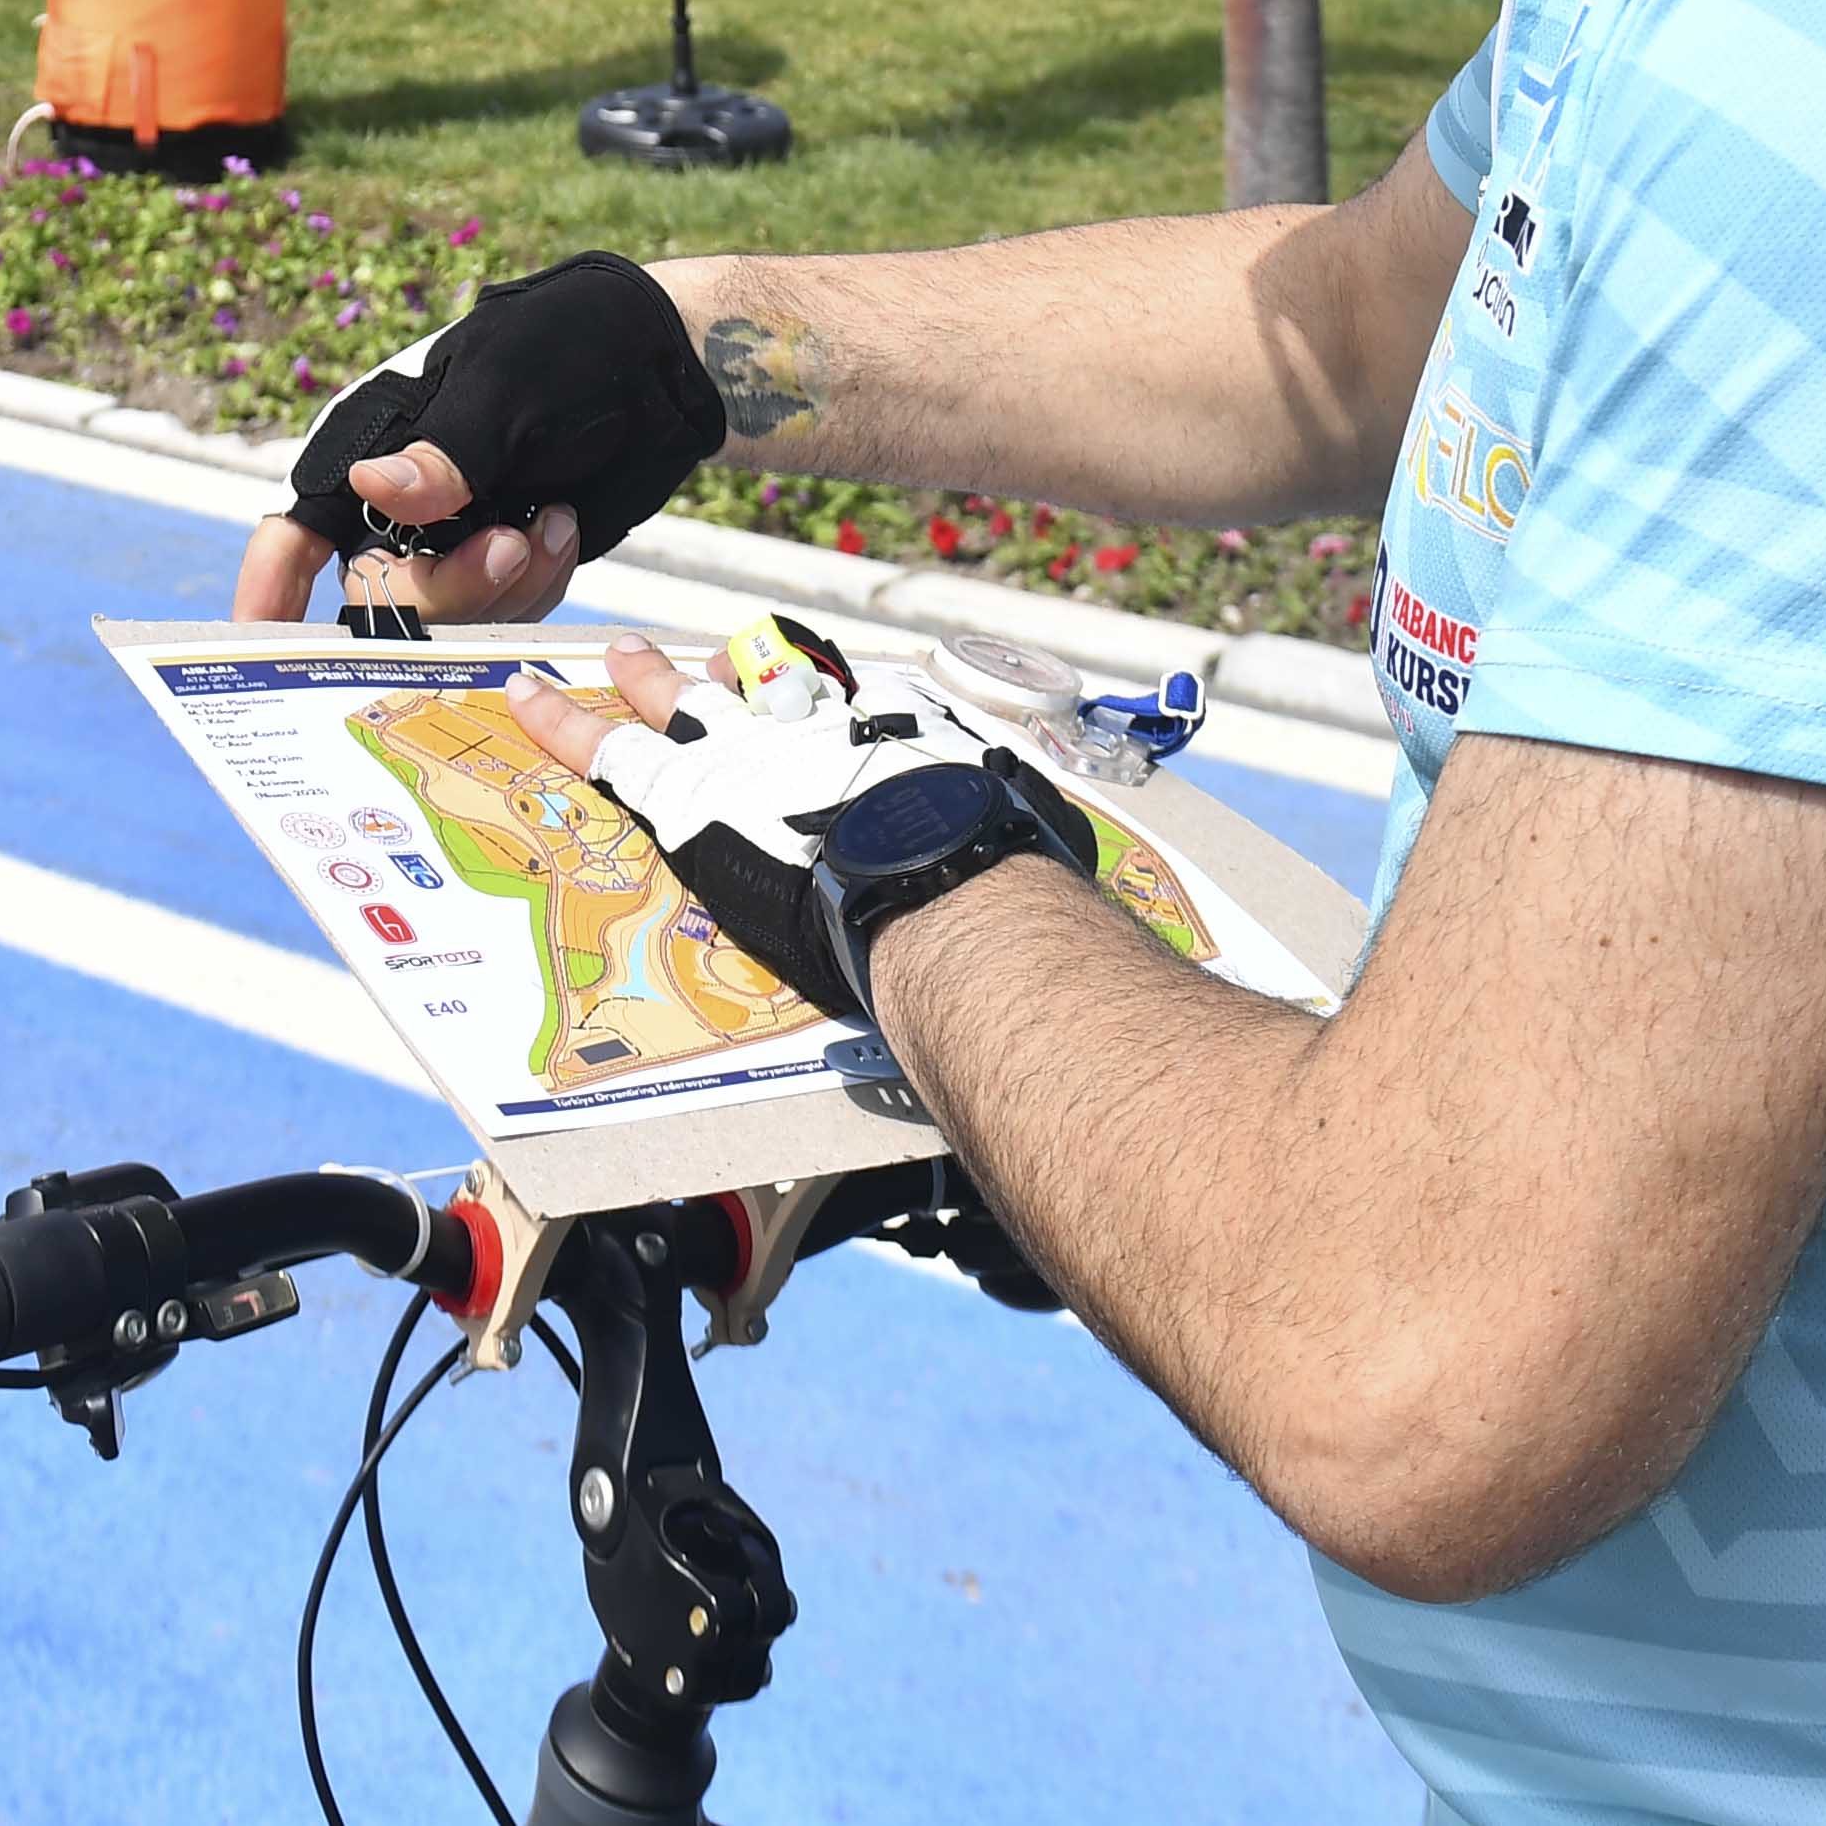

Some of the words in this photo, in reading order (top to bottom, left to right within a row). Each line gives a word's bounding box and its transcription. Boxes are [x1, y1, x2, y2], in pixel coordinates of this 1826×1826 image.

[1391, 580, 1479, 665] YABANC
[181, 664, 238, 676] ANKARA
[423, 999, 468, 1018] E40
